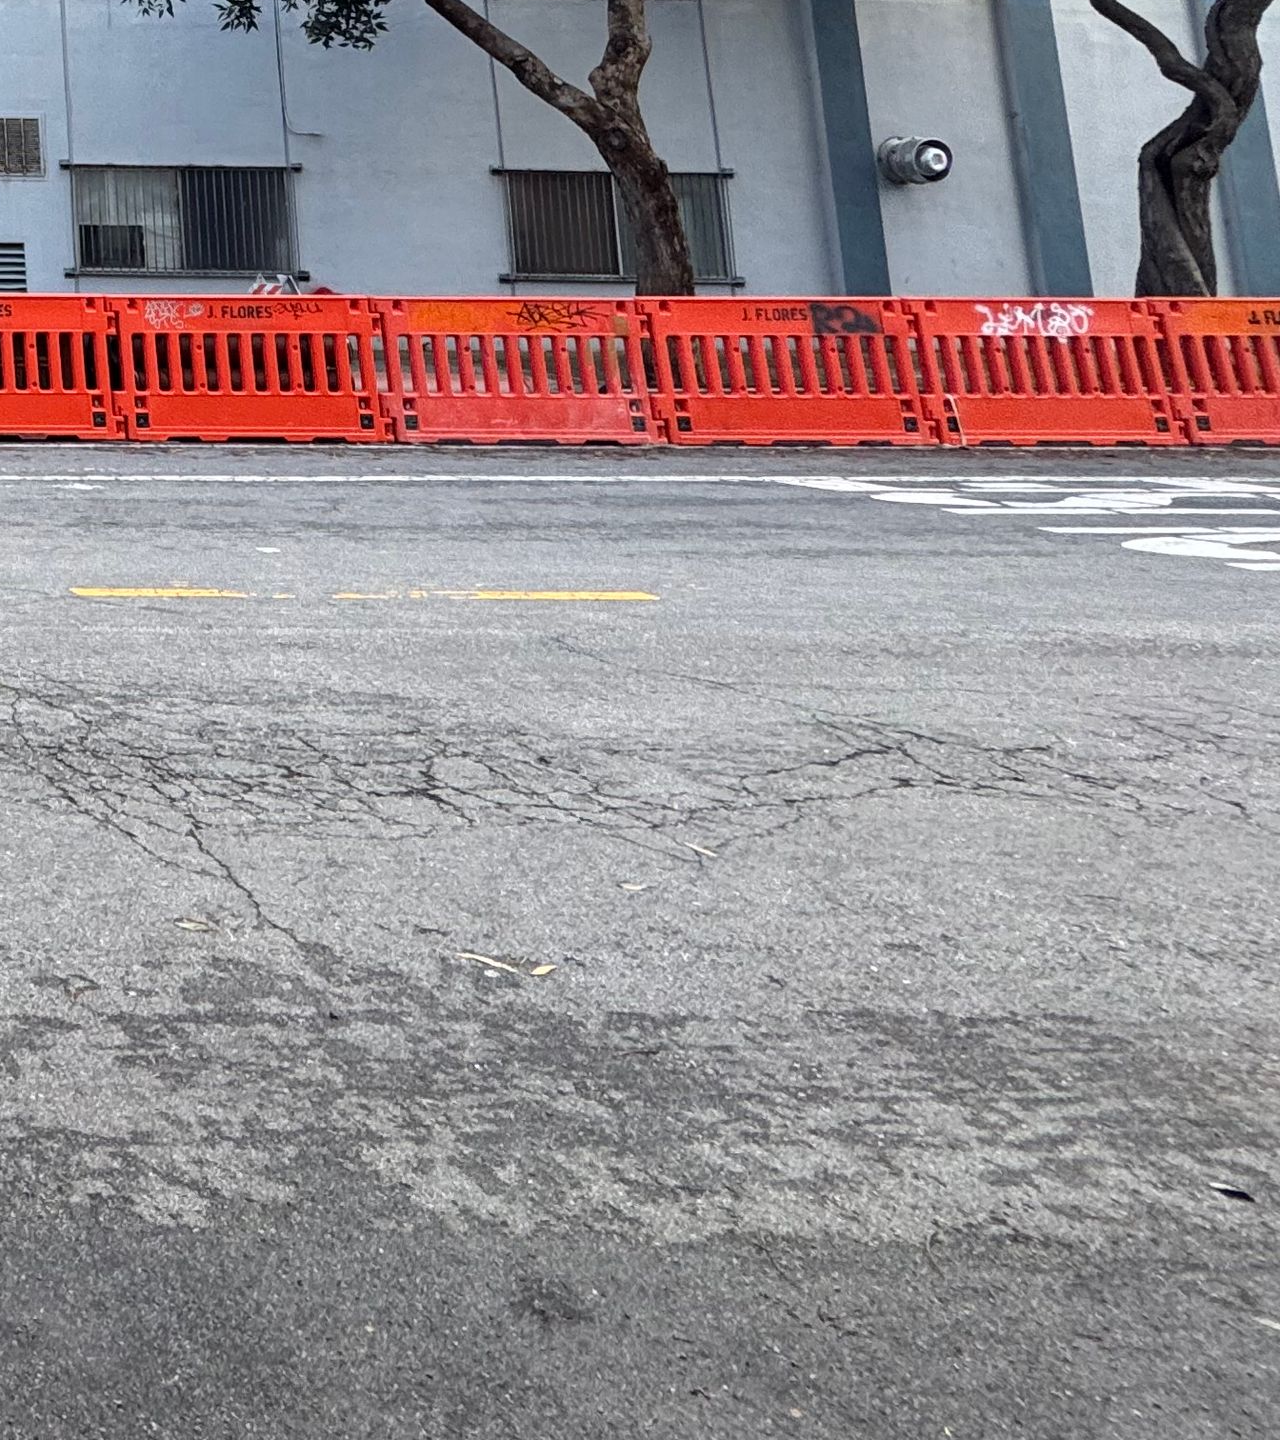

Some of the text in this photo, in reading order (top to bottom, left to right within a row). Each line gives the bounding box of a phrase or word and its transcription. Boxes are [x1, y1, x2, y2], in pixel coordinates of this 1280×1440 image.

[207, 305, 218, 319] J.
[221, 304, 273, 319] FLORES
[755, 307, 808, 321] FLORES
